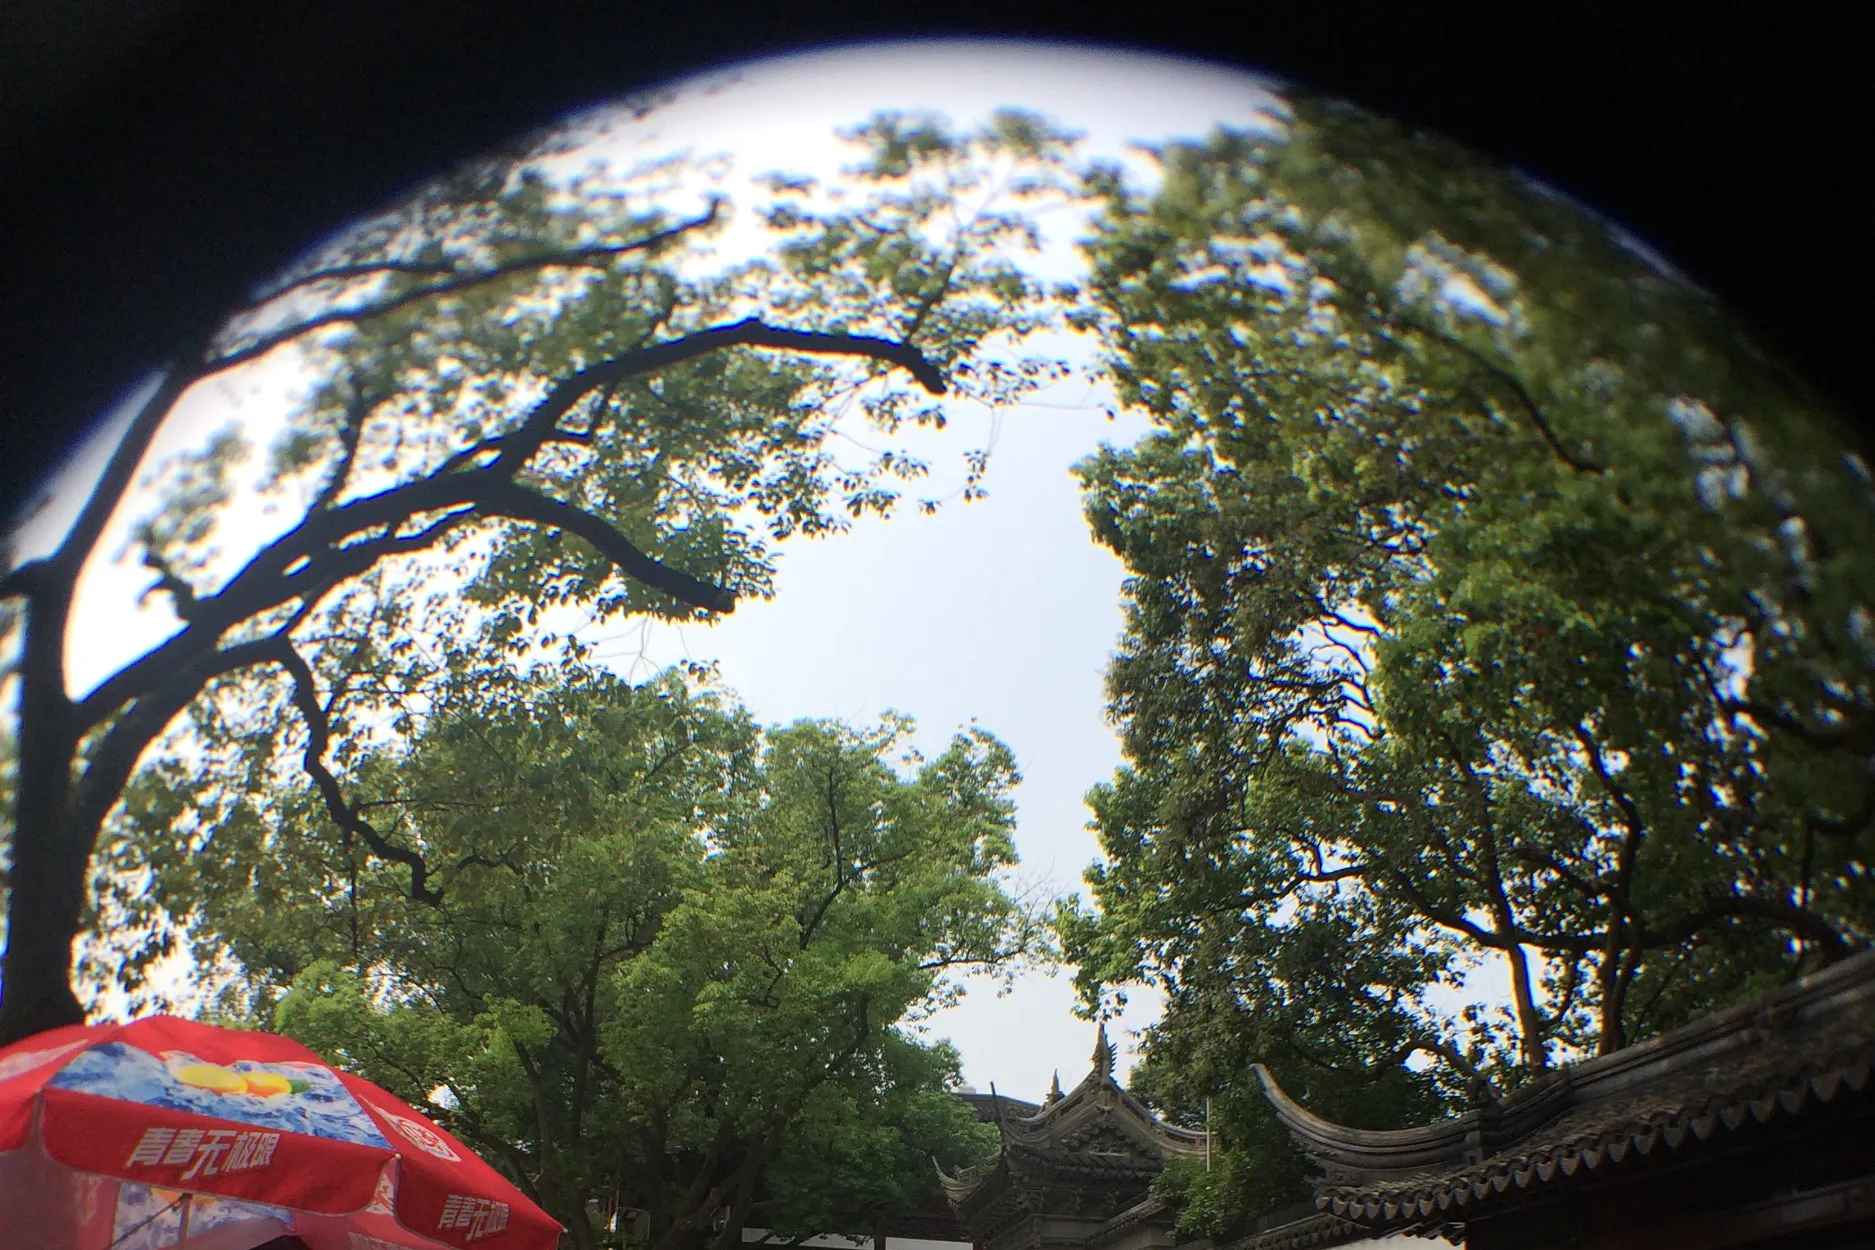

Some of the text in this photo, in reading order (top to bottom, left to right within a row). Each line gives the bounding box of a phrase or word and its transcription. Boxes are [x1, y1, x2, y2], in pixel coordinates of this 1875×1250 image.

[125, 1127, 281, 1181] 青春无极限
